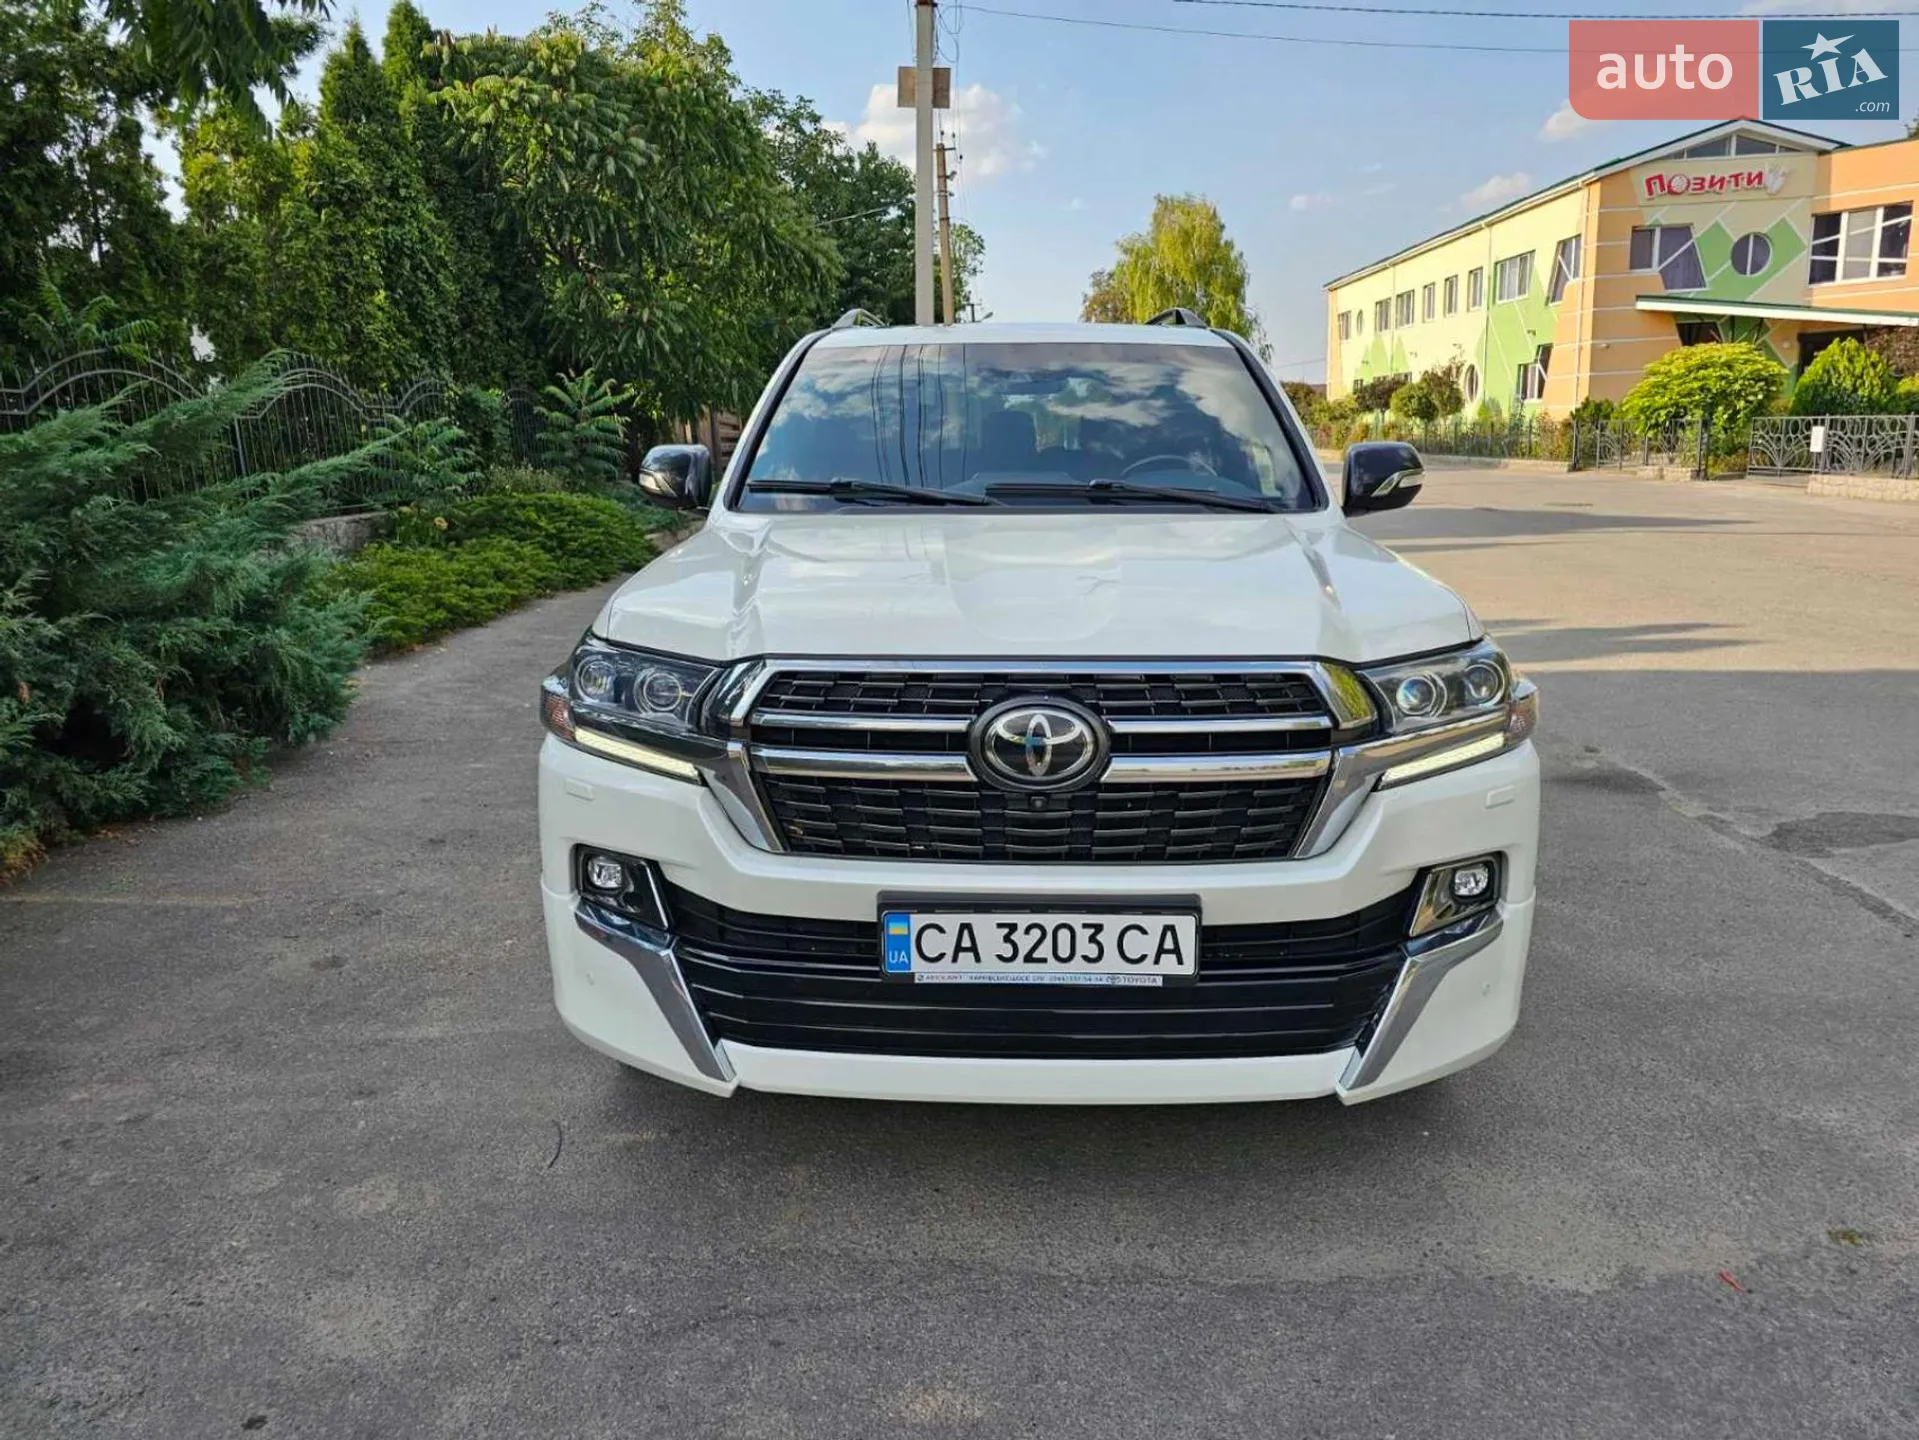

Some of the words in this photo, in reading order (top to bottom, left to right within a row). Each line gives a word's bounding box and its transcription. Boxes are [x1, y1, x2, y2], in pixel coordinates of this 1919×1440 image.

[888, 951, 909, 964] UA
[915, 922, 982, 964] CA
[995, 922, 1105, 964] 3203
[1117, 923, 1184, 966] CA
